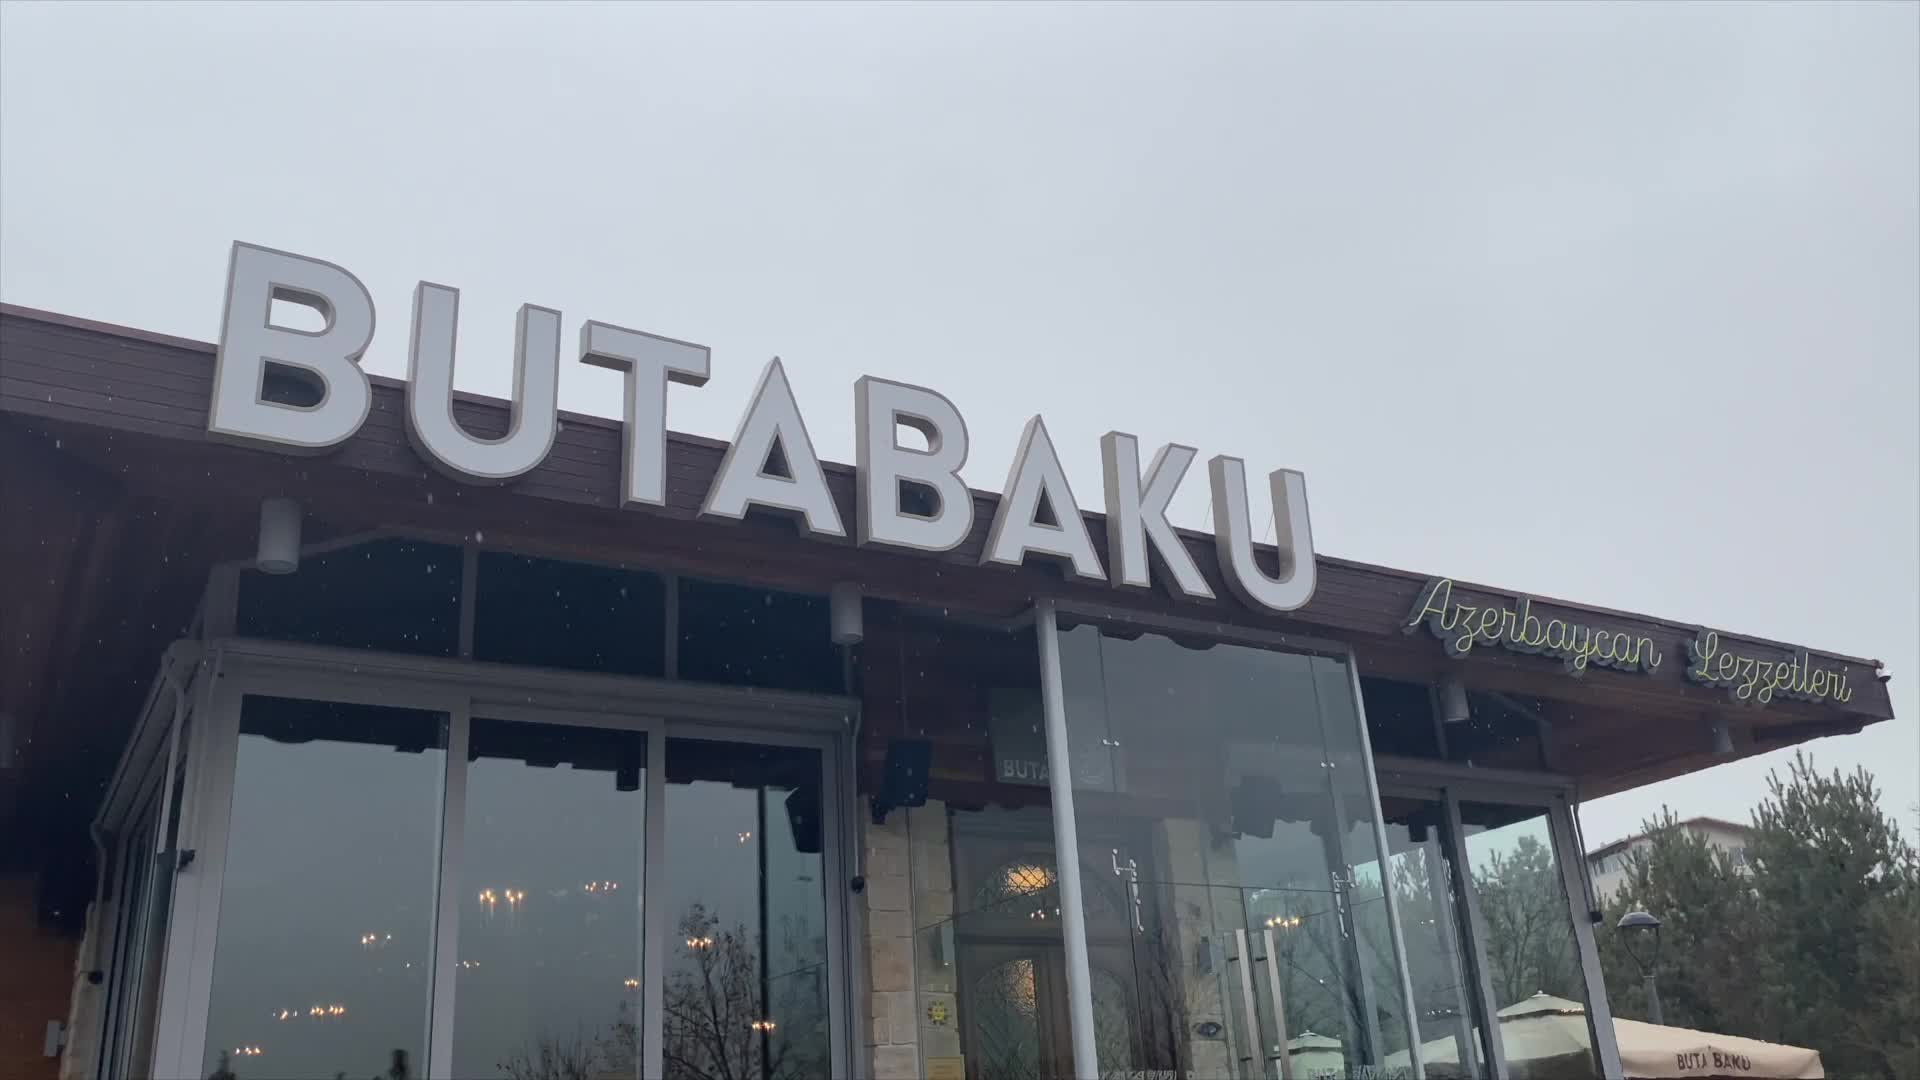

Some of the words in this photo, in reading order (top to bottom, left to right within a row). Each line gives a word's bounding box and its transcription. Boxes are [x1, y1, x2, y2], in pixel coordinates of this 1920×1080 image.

[1408, 578, 1662, 669] Azerbaycan
[1695, 631, 1852, 703] Lezzetleri
[1713, 1052, 1751, 1071] BAKU
